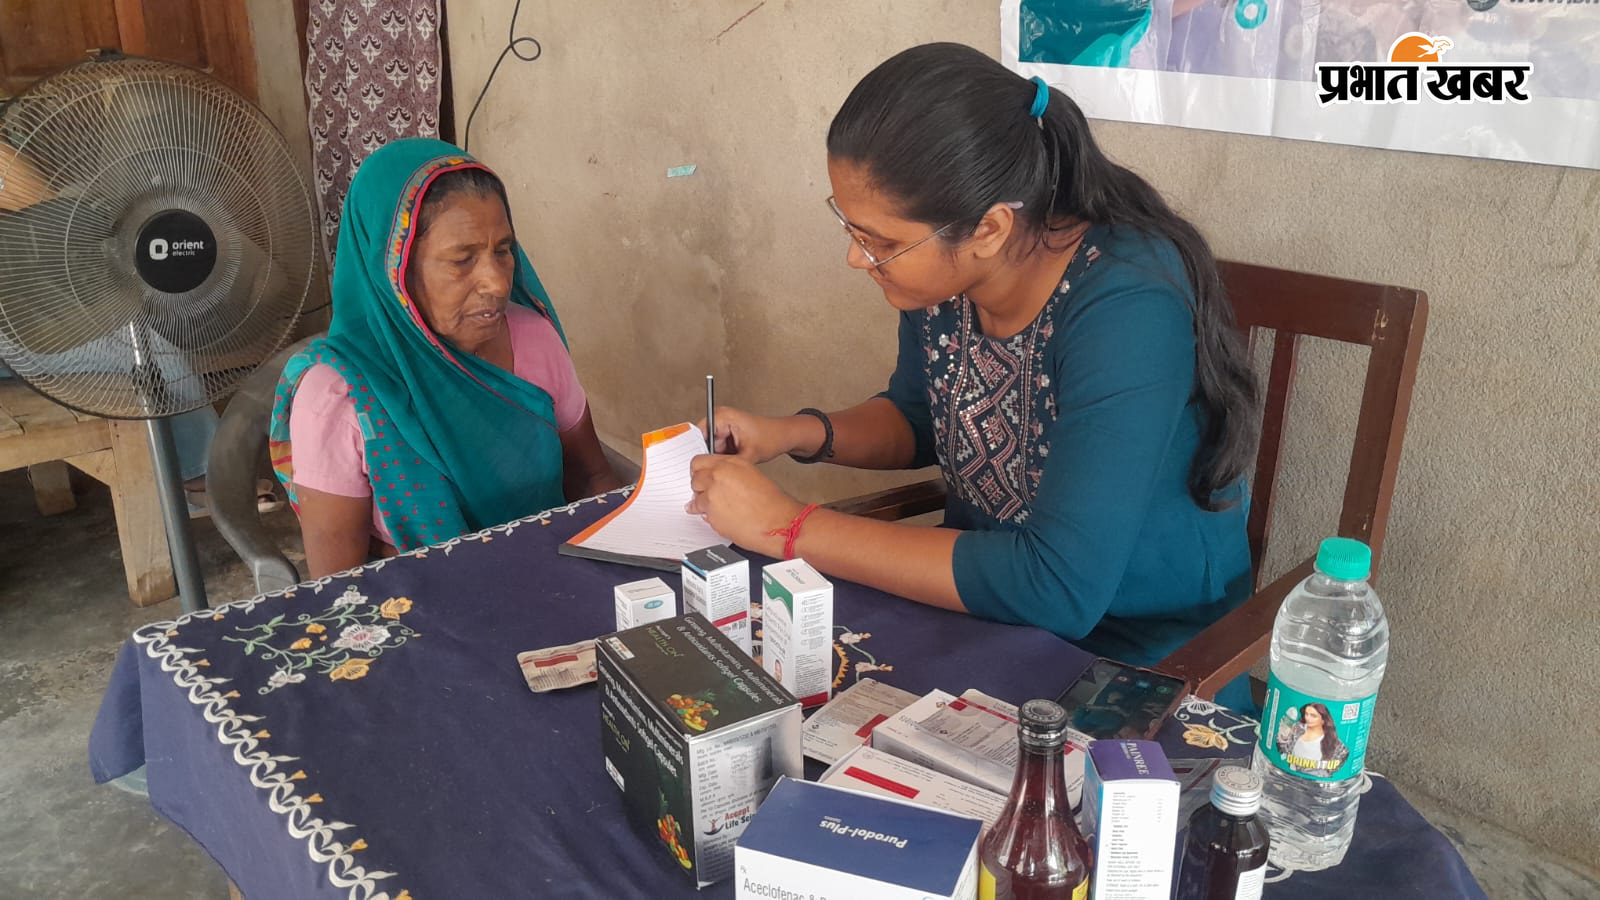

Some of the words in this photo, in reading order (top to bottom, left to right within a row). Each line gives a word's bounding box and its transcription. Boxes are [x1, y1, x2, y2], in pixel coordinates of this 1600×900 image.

[172, 240, 204, 250] orient
[724, 805, 750, 821] Accept
[725, 820, 739, 830] Life
[819, 819, 908, 849] Purodol-Plus
